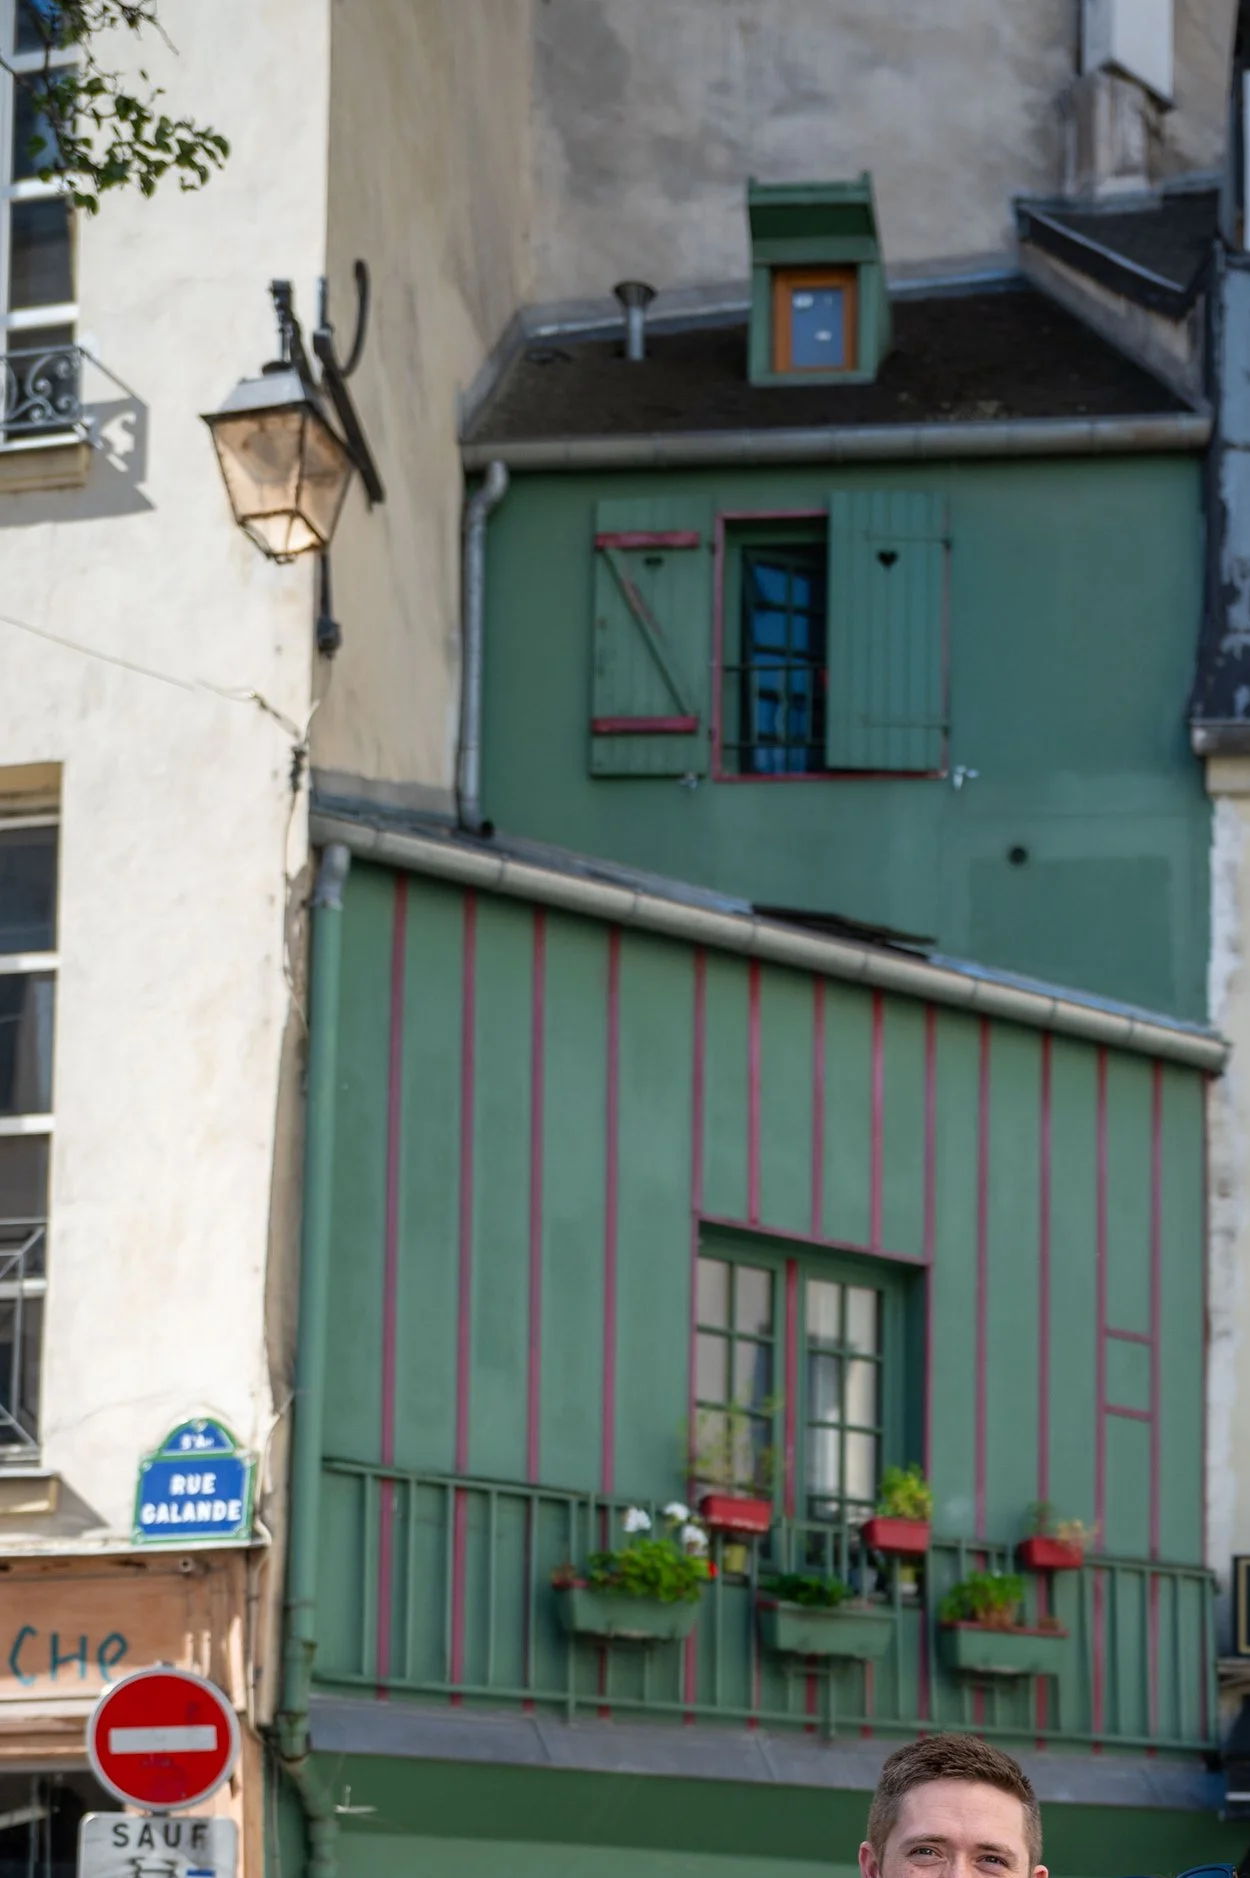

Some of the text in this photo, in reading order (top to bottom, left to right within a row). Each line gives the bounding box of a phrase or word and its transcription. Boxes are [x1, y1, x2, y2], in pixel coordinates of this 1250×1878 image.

[168, 1472, 217, 1496] RUE
[141, 1500, 242, 1525] GALANDE
[111, 1822, 209, 1849] SAUF
